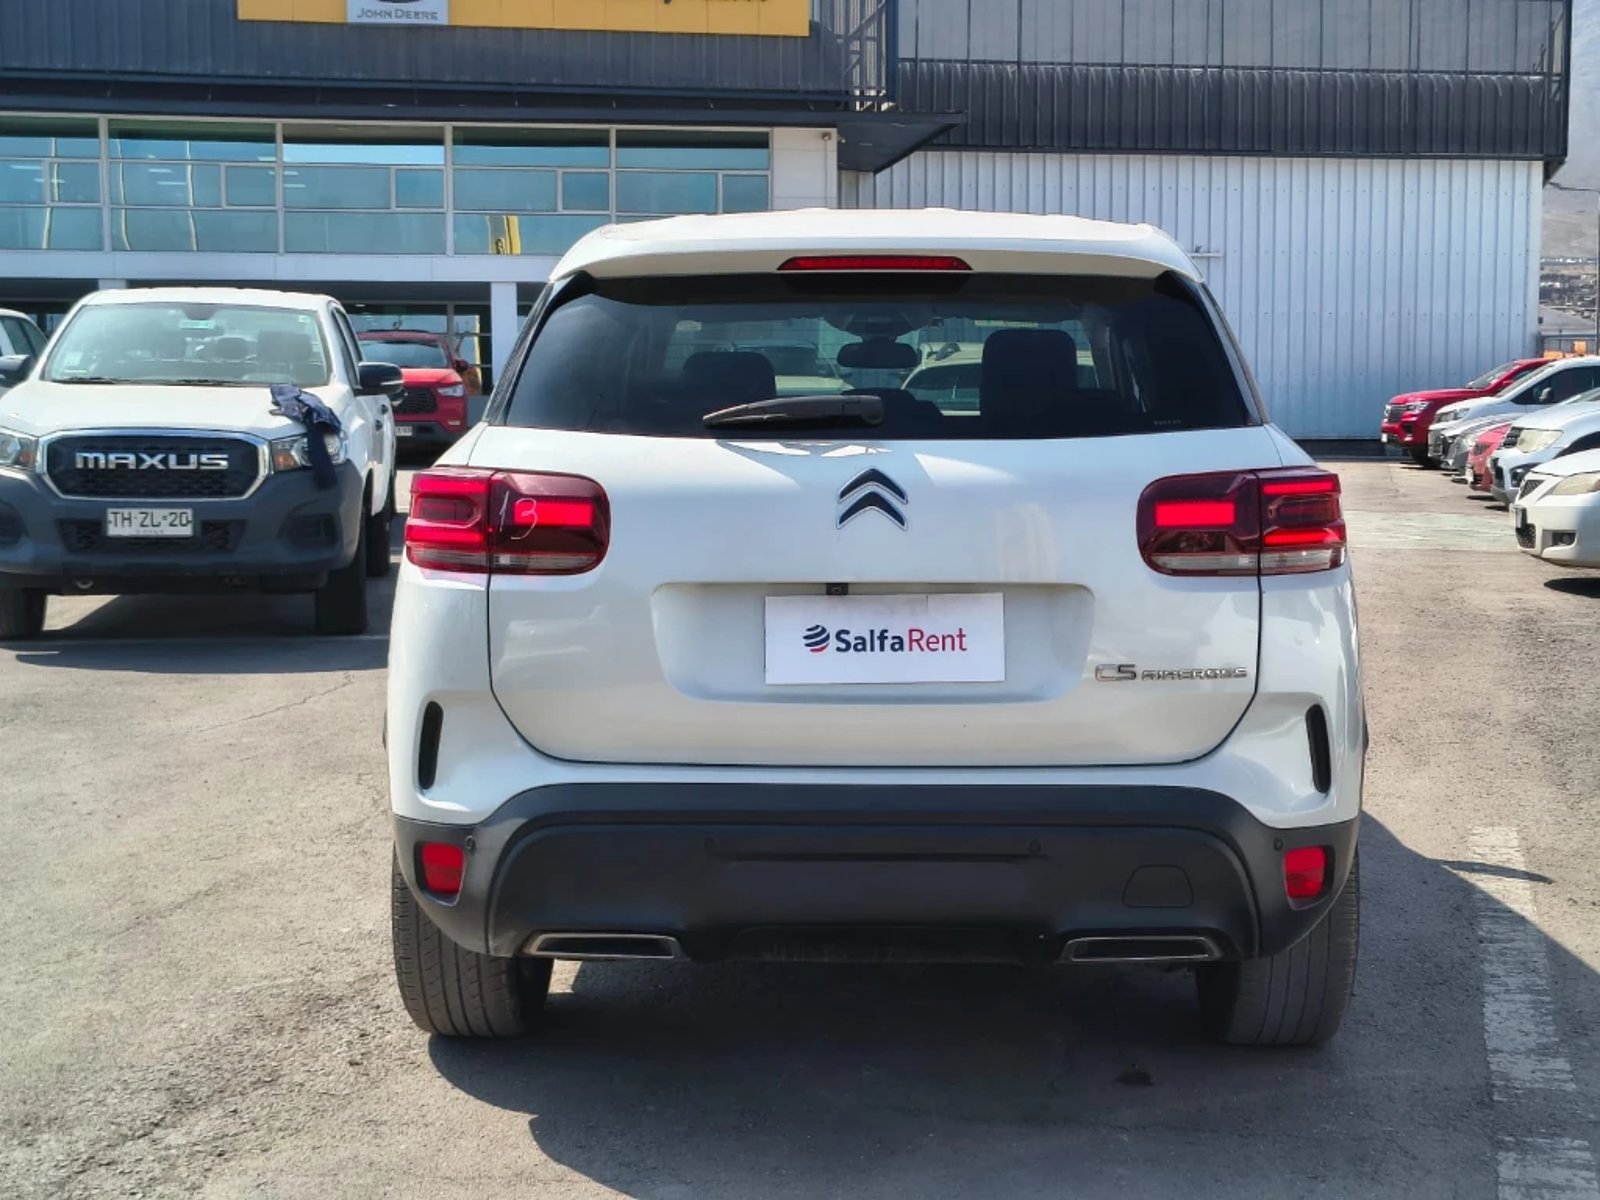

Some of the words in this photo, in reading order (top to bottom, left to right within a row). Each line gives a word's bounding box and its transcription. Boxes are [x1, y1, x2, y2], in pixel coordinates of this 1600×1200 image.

[356, 8, 393, 20] JOHN
[394, 9, 439, 21] DEERE
[75, 452, 229, 470] MAXUS
[1095, 663, 1137, 682] C5
